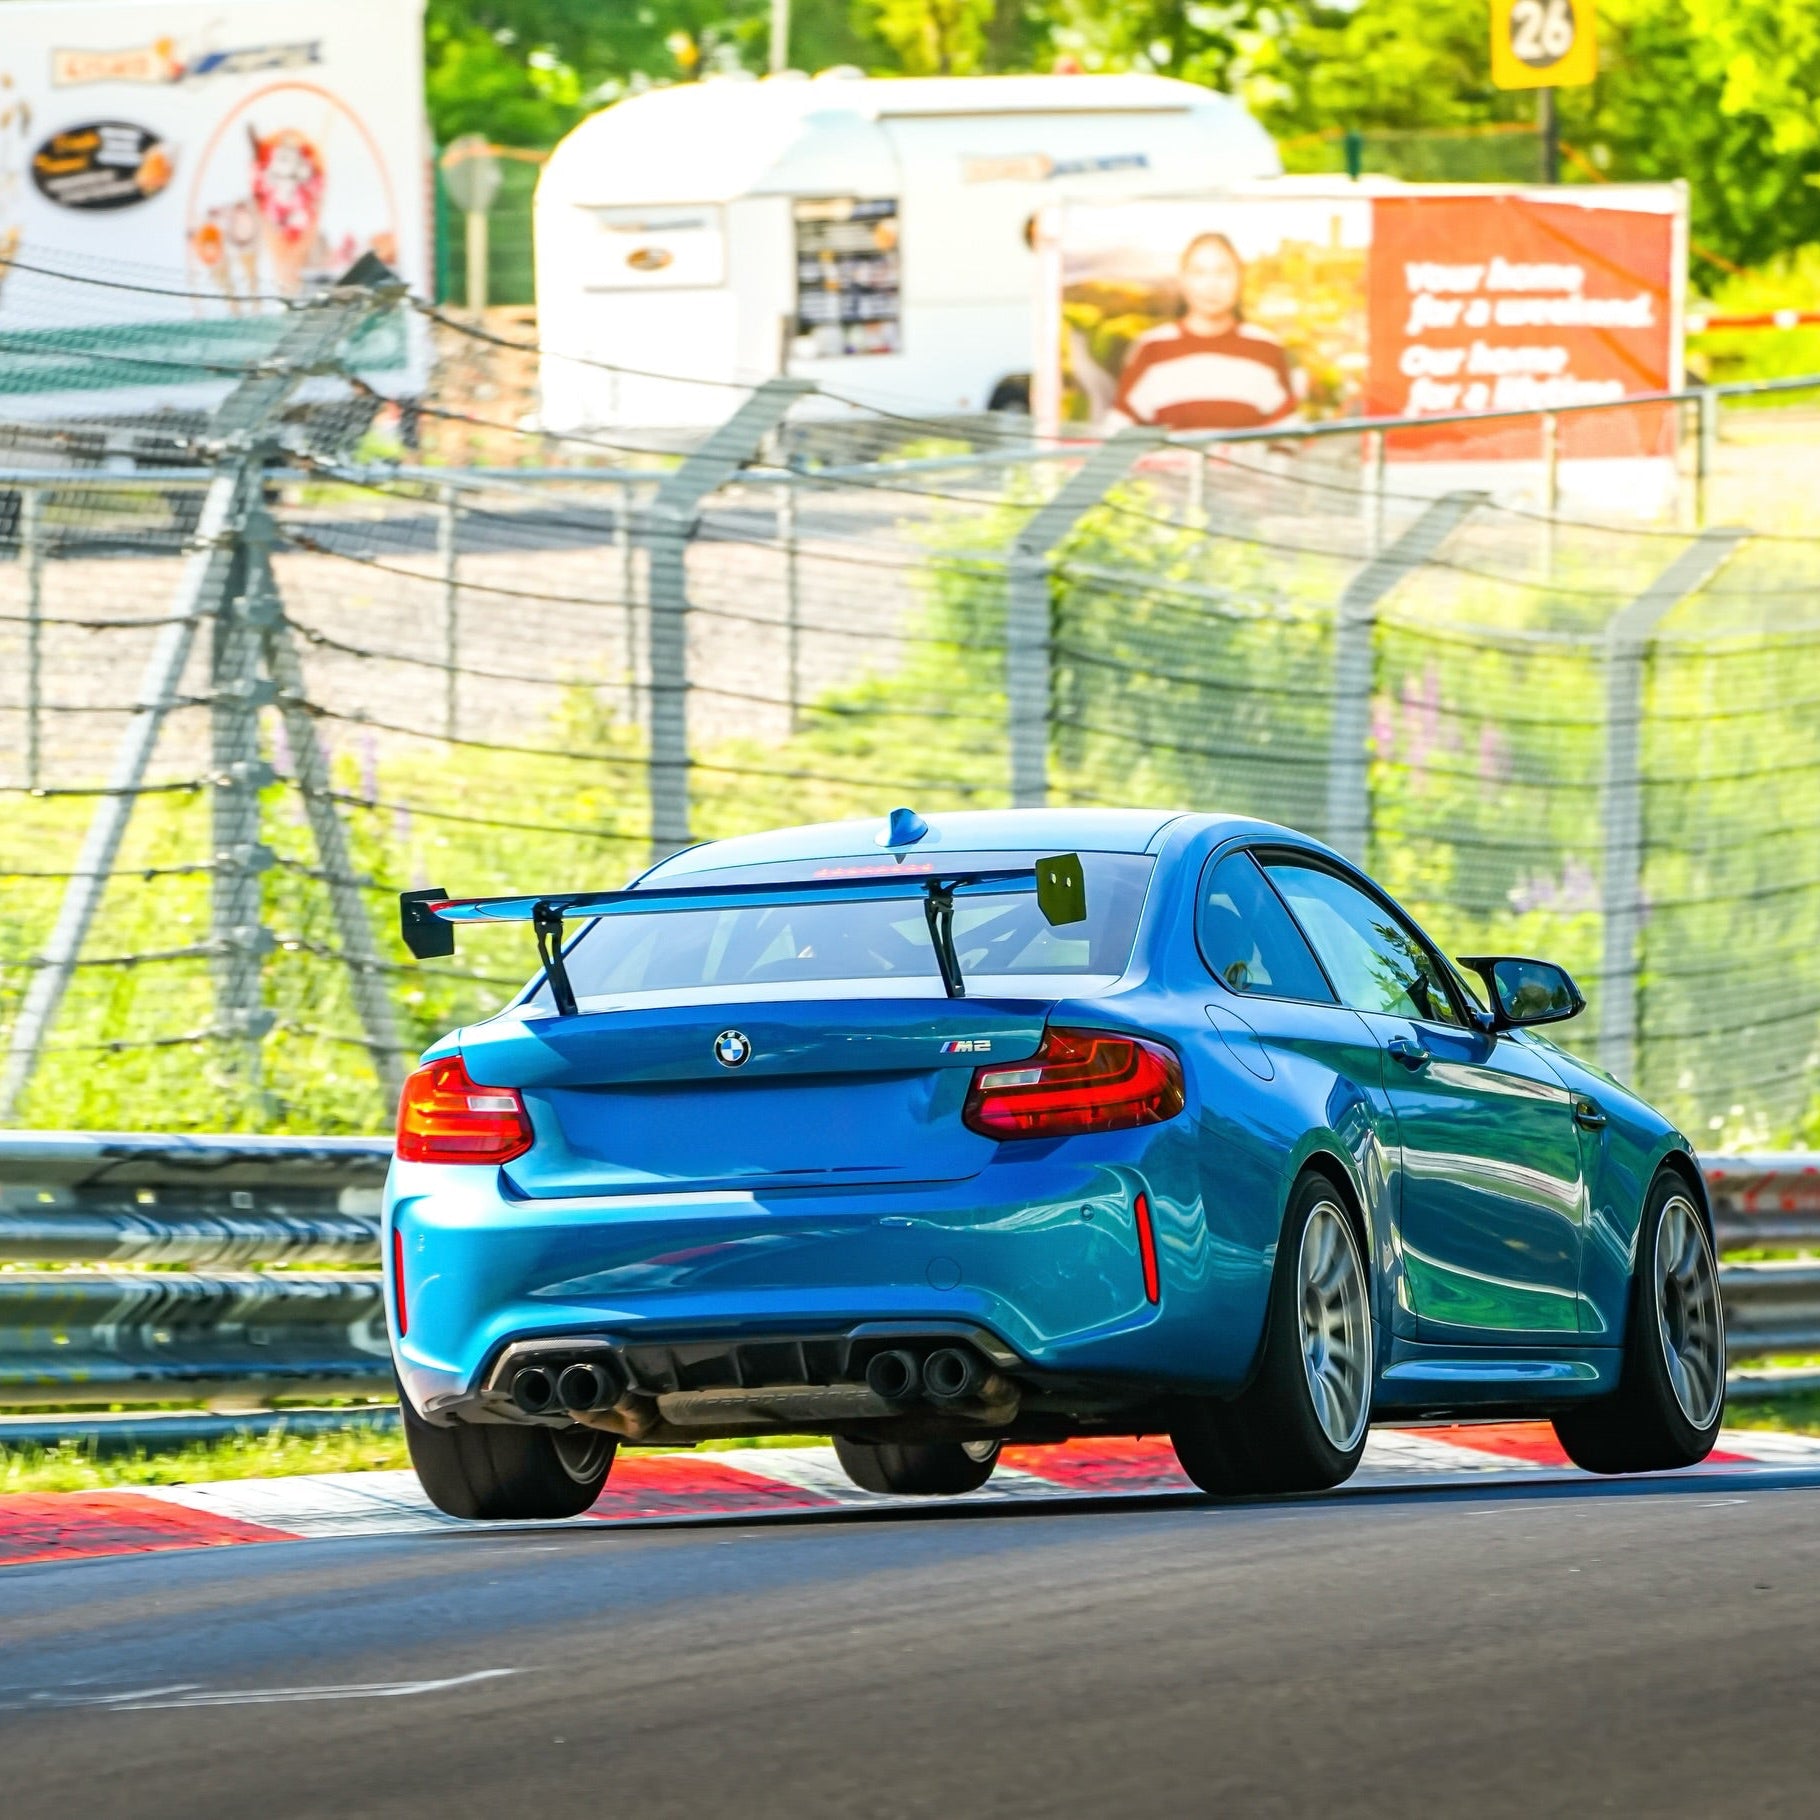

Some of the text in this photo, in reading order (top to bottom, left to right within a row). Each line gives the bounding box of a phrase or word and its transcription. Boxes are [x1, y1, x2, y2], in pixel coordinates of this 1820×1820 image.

[1511, 0, 1574, 59] 26
[1486, 258, 1584, 291] home
[1407, 294, 1462, 333] for
[1464, 300, 1490, 326] a
[1401, 342, 1568, 375] Our home
[1405, 378, 1460, 418] for
[1464, 384, 1488, 412] a
[953, 1040, 991, 1053] M2
